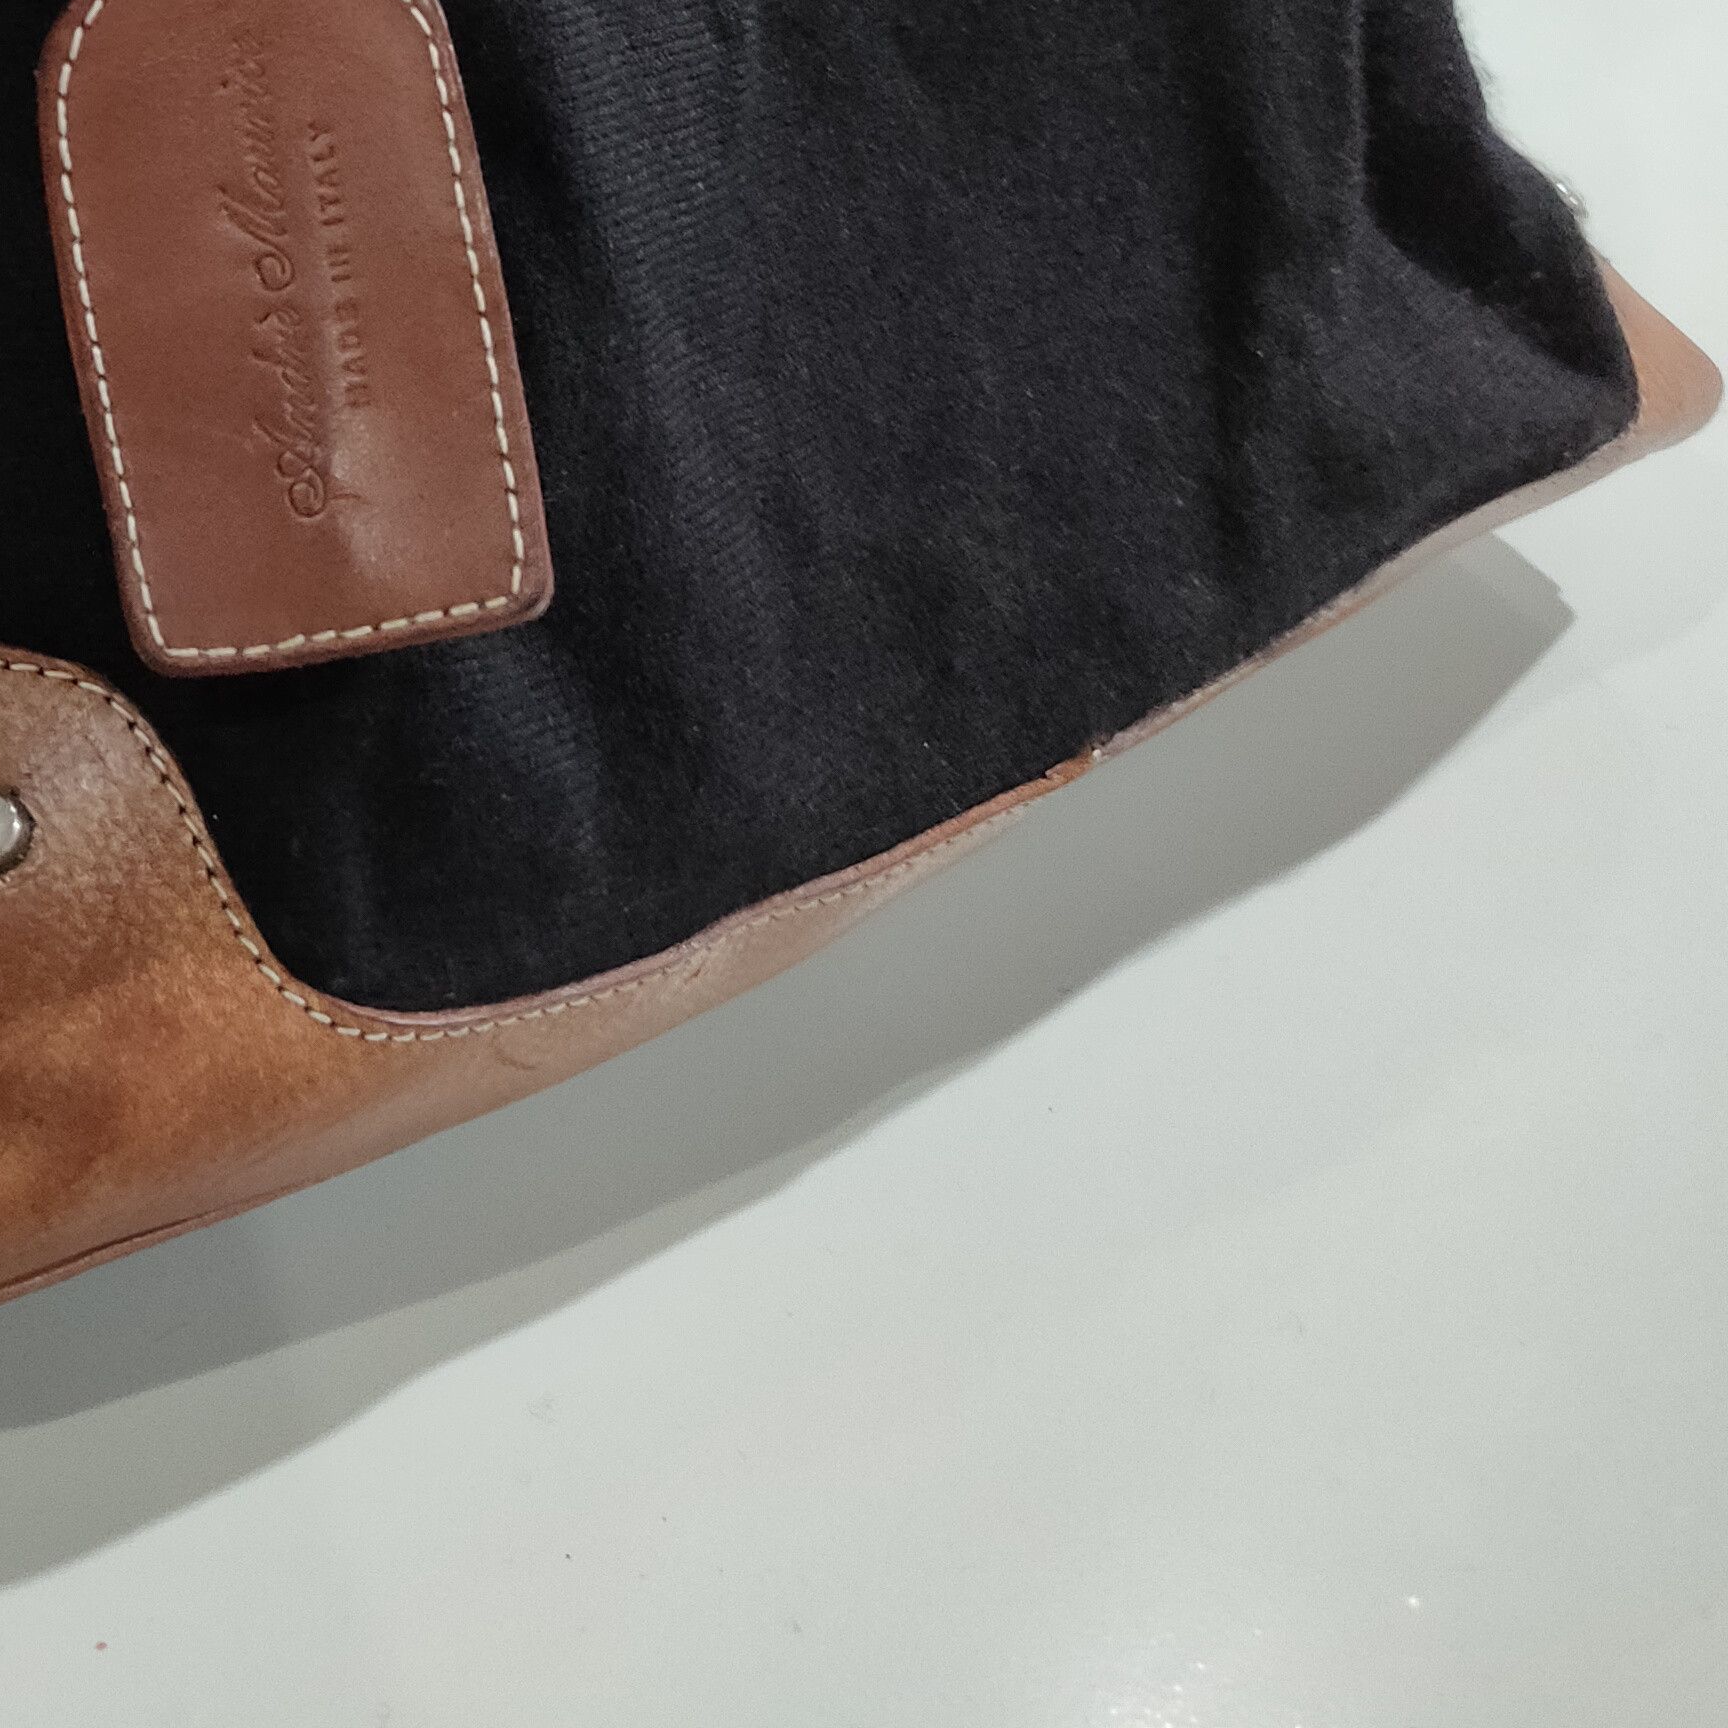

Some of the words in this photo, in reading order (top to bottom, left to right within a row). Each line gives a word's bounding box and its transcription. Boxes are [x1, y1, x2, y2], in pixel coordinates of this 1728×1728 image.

[307, 120, 345, 227] ITALY
[326, 243, 353, 284] IN
[333, 298, 371, 410] MADE
